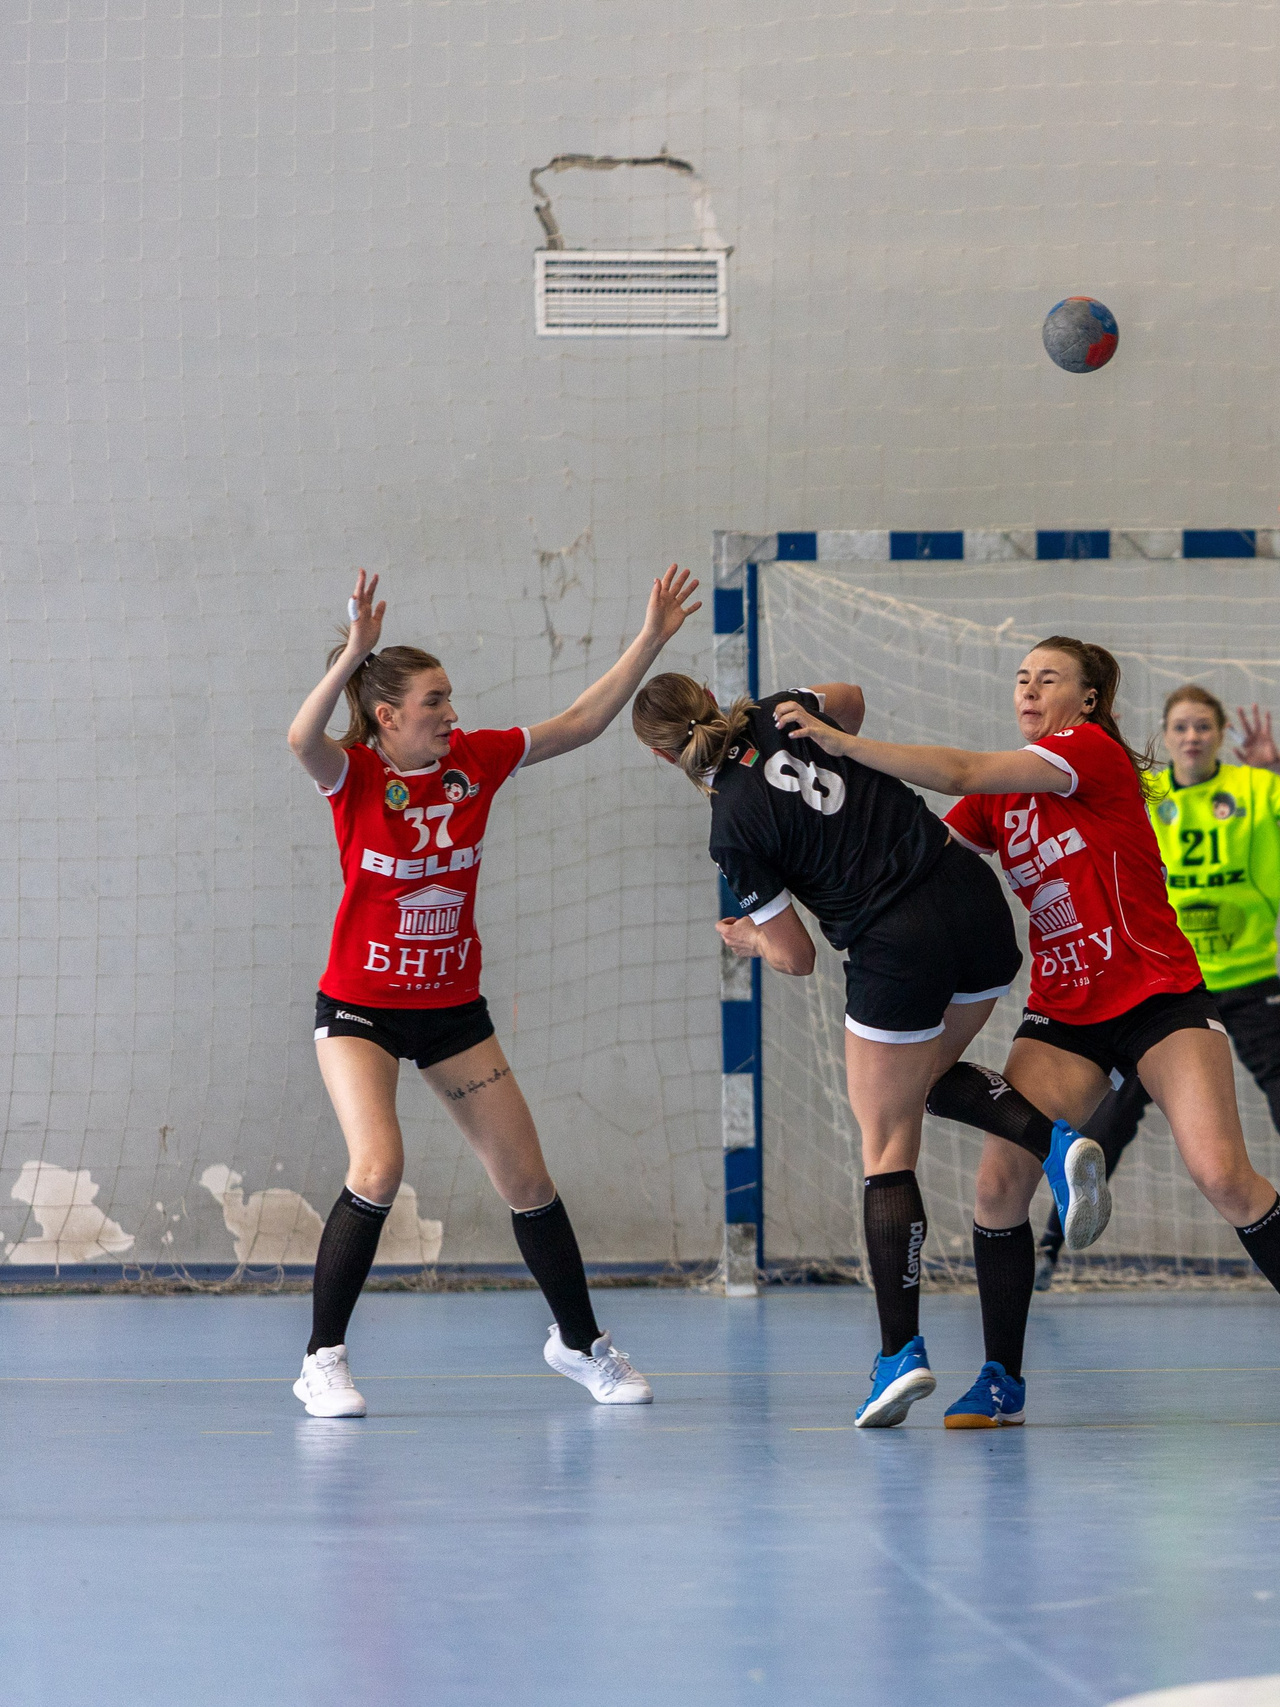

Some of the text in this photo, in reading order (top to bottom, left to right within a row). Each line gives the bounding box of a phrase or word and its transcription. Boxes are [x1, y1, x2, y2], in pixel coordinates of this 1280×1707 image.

[763, 749, 846, 816] 8
[403, 803, 454, 853] 37
[1180, 829, 1222, 866] 21
[1168, 869, 1246, 889] ELAZ
[363, 937, 473, 978] БНТУ
[1036, 926, 1113, 977] БНУ
[406, 981, 441, 991] 1920
[902, 1220, 924, 1290] Kempa
